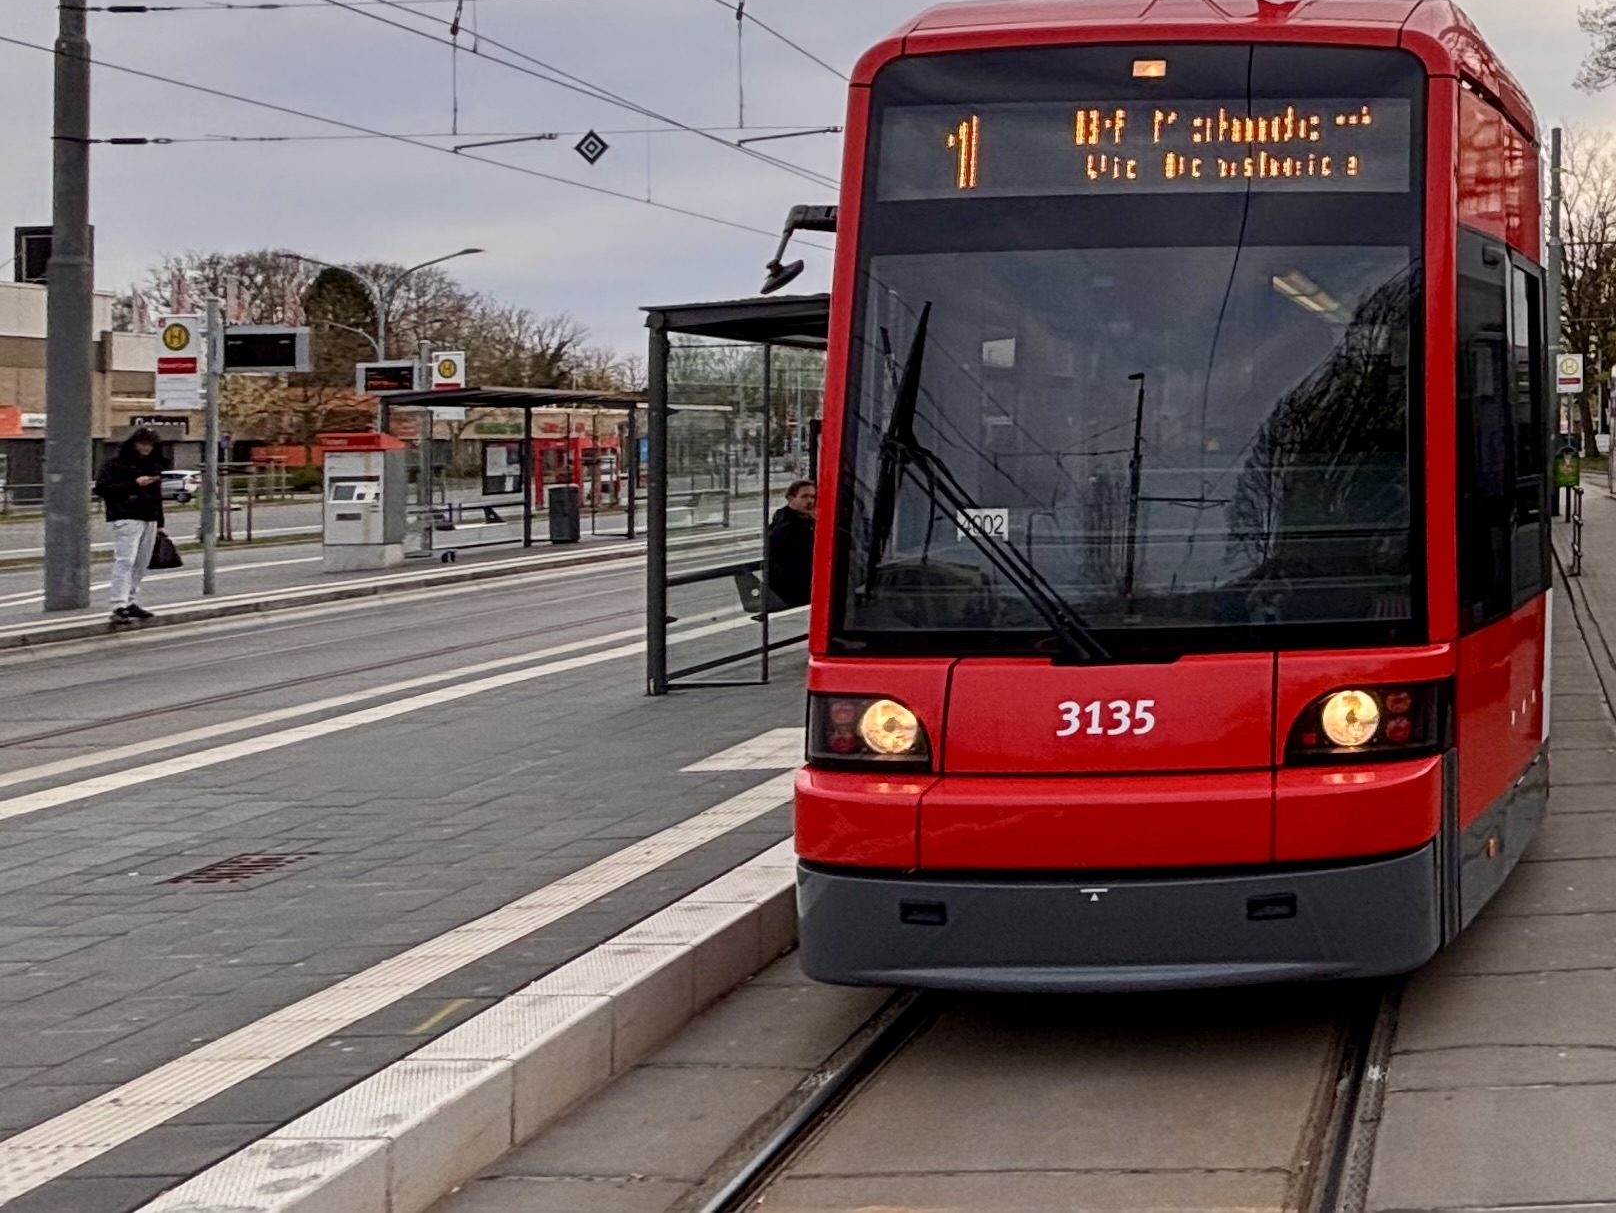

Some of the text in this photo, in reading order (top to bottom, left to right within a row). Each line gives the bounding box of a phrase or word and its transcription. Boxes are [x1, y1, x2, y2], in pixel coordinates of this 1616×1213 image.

[947, 114, 979, 188] 1
[962, 514, 1005, 535] 4002
[1056, 699, 1156, 737] 3135
